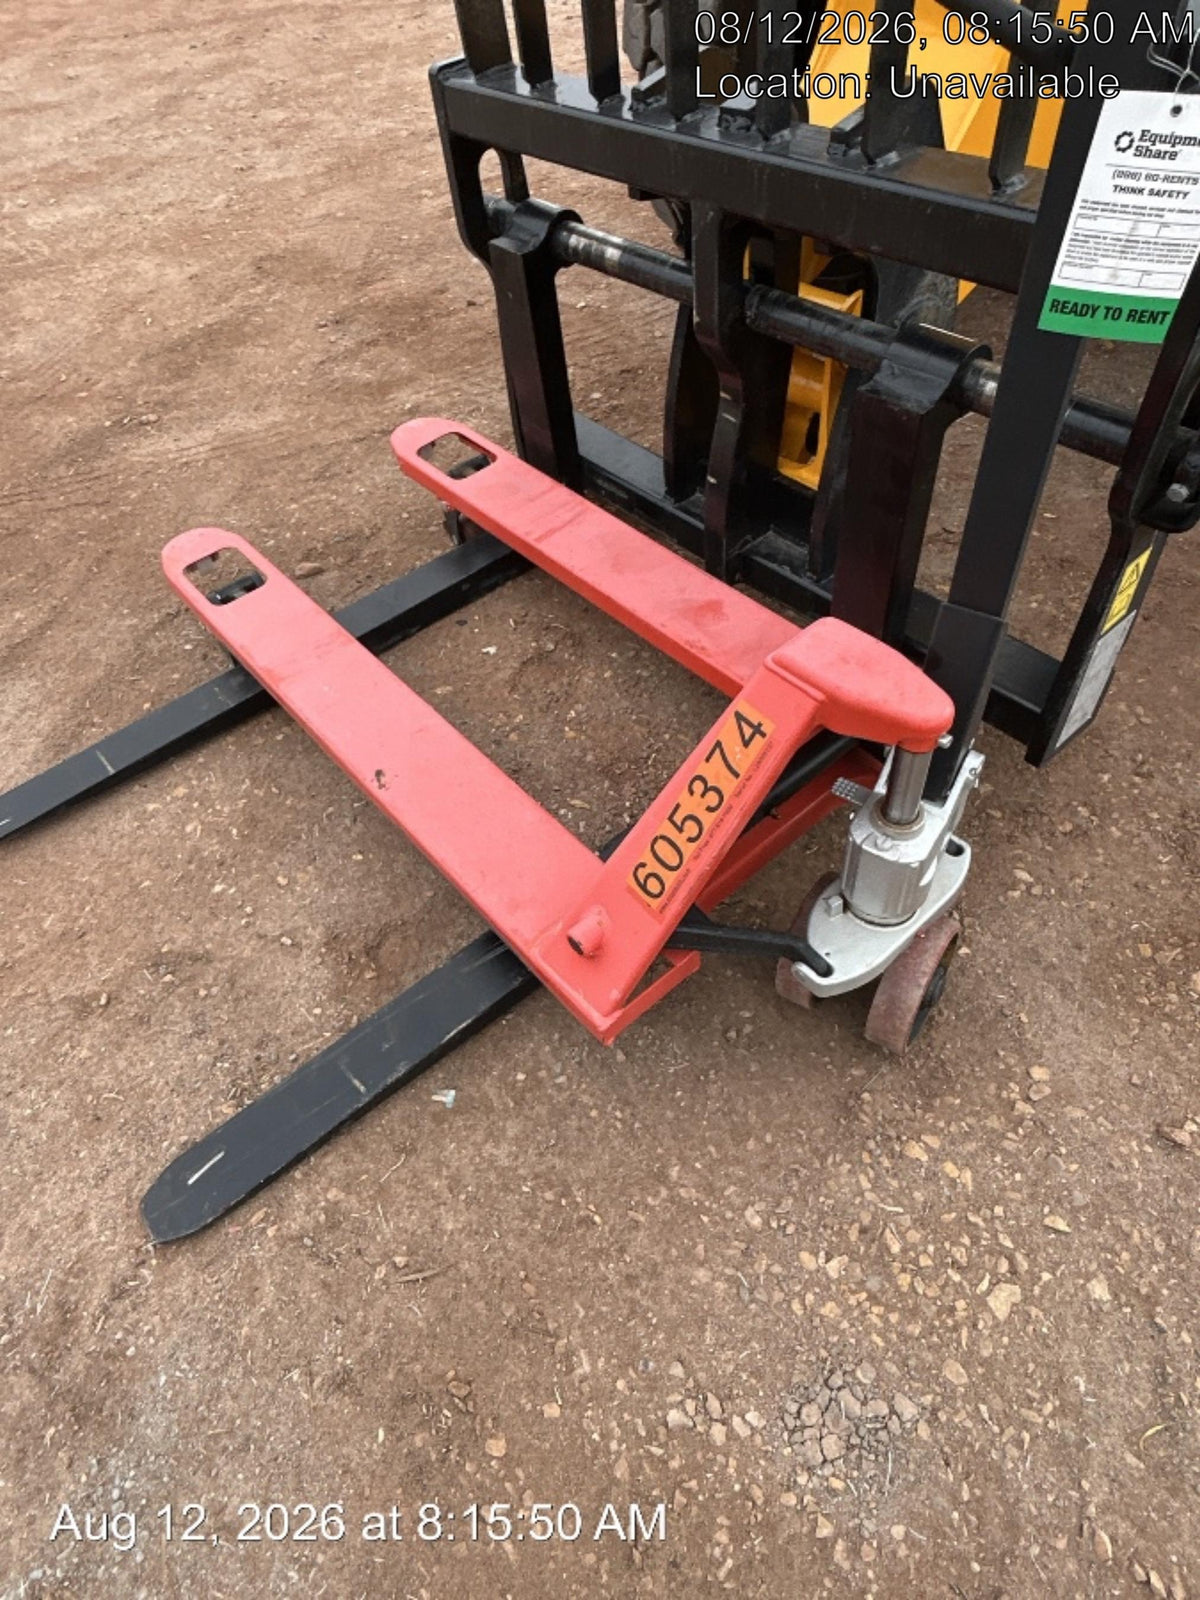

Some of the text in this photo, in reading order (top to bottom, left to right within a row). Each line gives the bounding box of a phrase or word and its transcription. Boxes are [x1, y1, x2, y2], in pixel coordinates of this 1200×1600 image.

[1133, 145, 1178, 160] Share
[1112, 184, 1190, 200] THINK SAFETY
[1049, 298, 1170, 325] READY TO RENT
[632, 709, 767, 900] 605374
